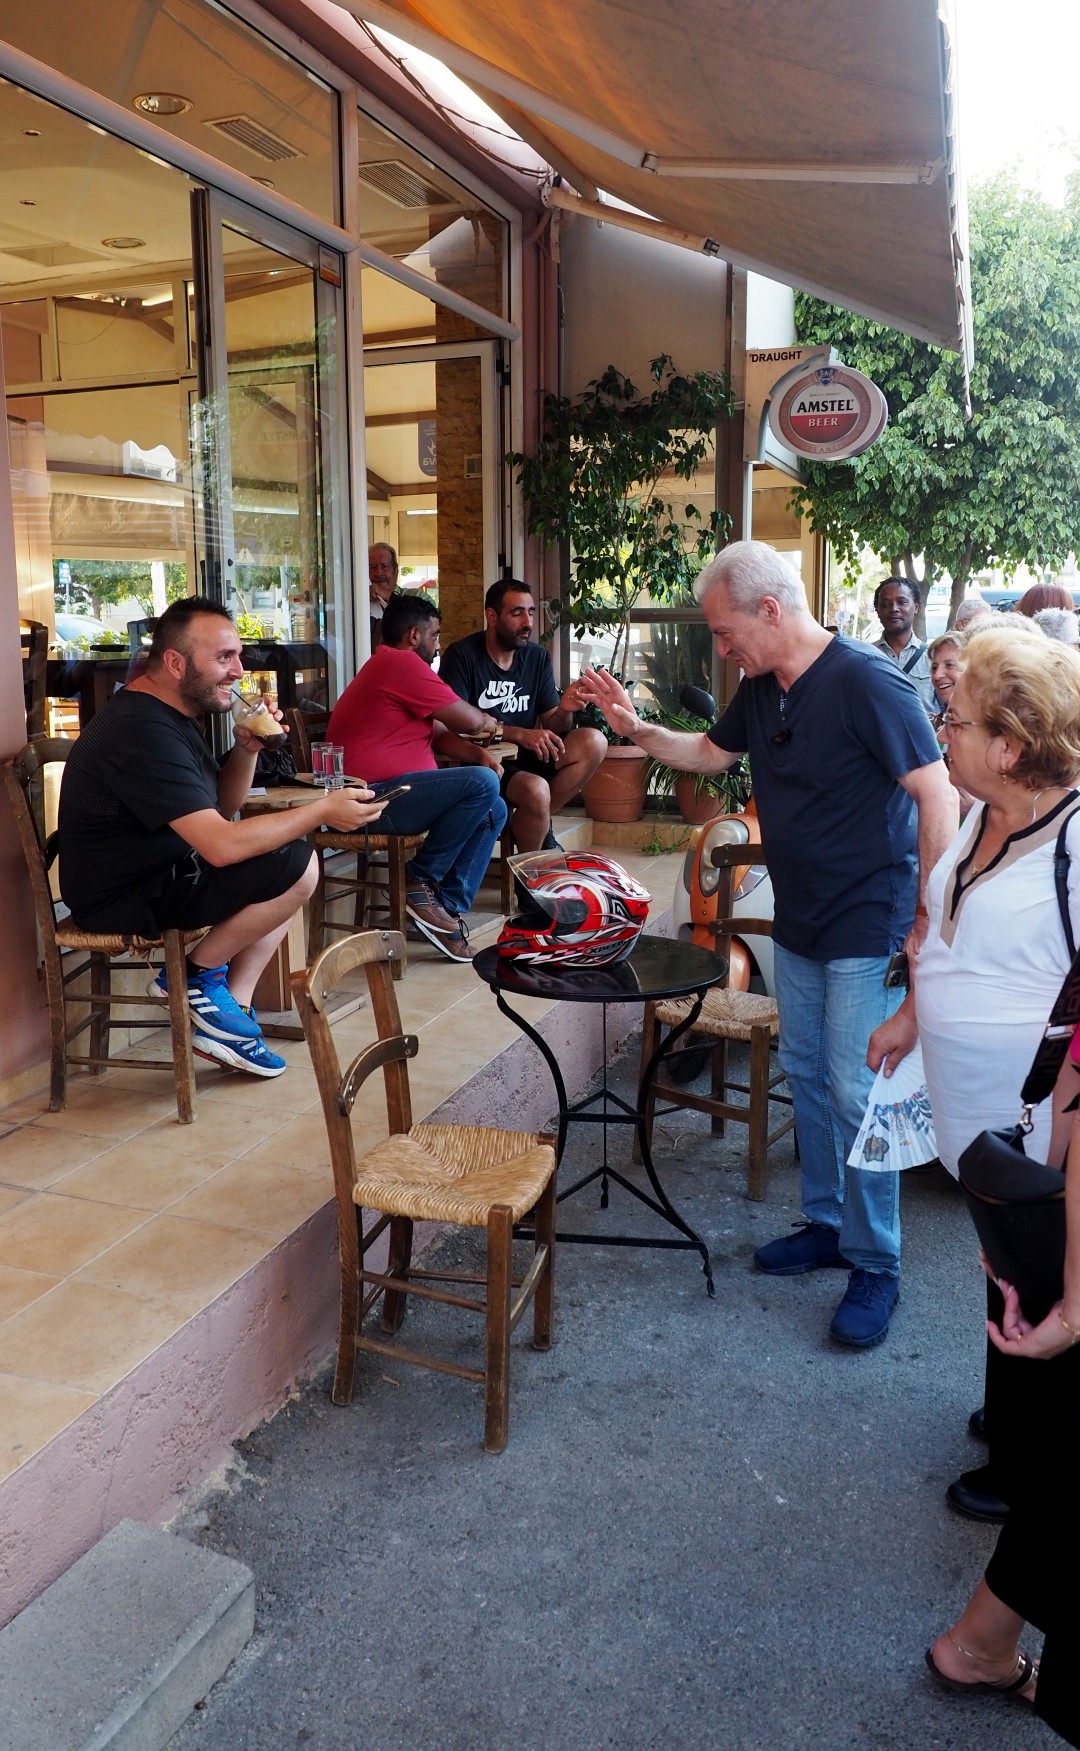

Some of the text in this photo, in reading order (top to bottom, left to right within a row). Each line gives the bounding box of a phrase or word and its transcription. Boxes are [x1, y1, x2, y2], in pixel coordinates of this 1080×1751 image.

[751, 350, 802, 363] DRAUGHT
[808, 417, 839, 427] BEER
[487, 681, 515, 696] JUST
